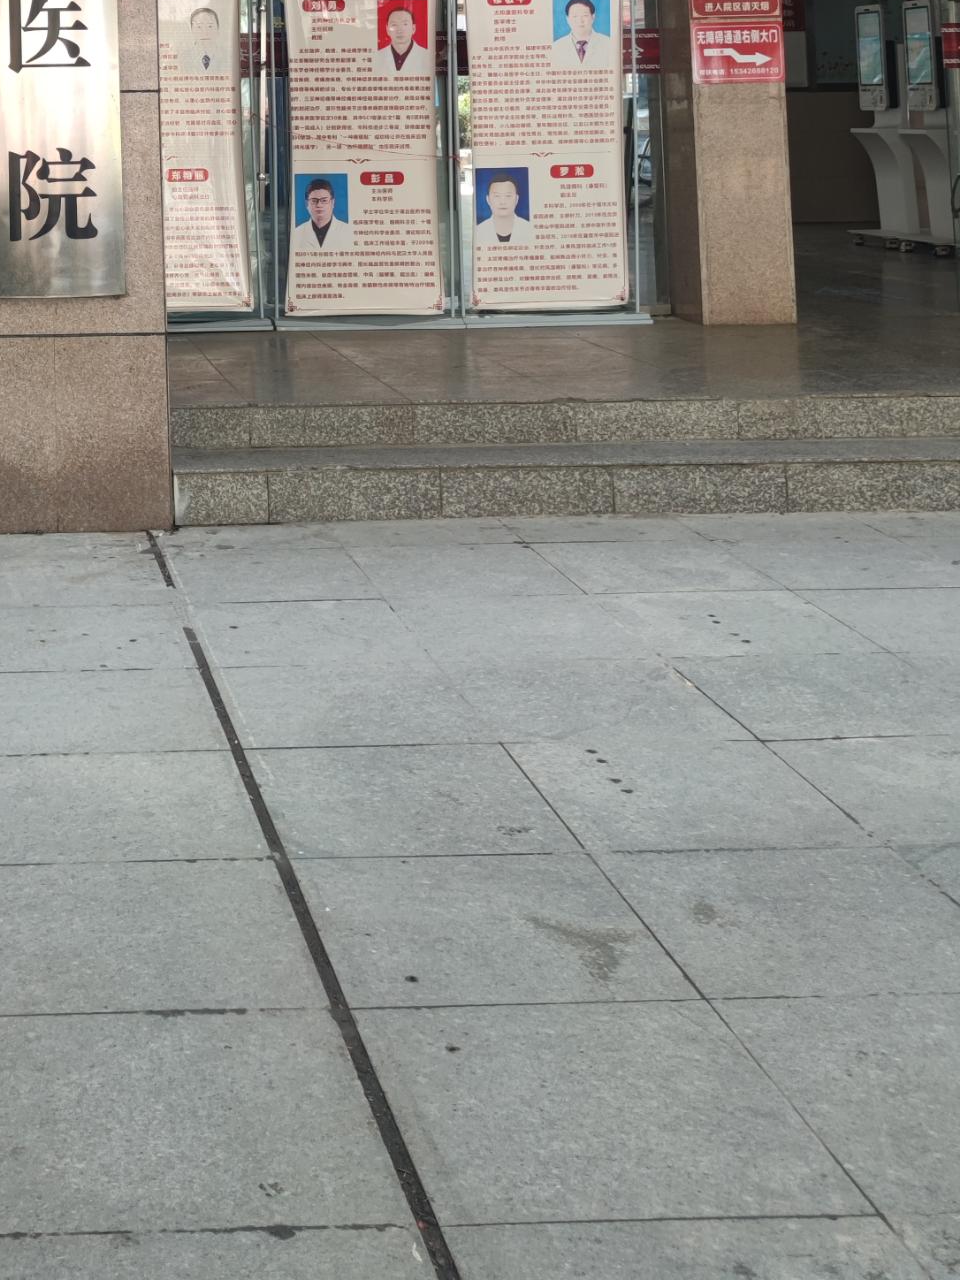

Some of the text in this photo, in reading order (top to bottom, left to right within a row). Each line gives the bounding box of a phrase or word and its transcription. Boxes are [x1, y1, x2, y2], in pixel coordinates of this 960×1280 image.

[697, 29, 778, 45] 无障碍通道右侧大门
